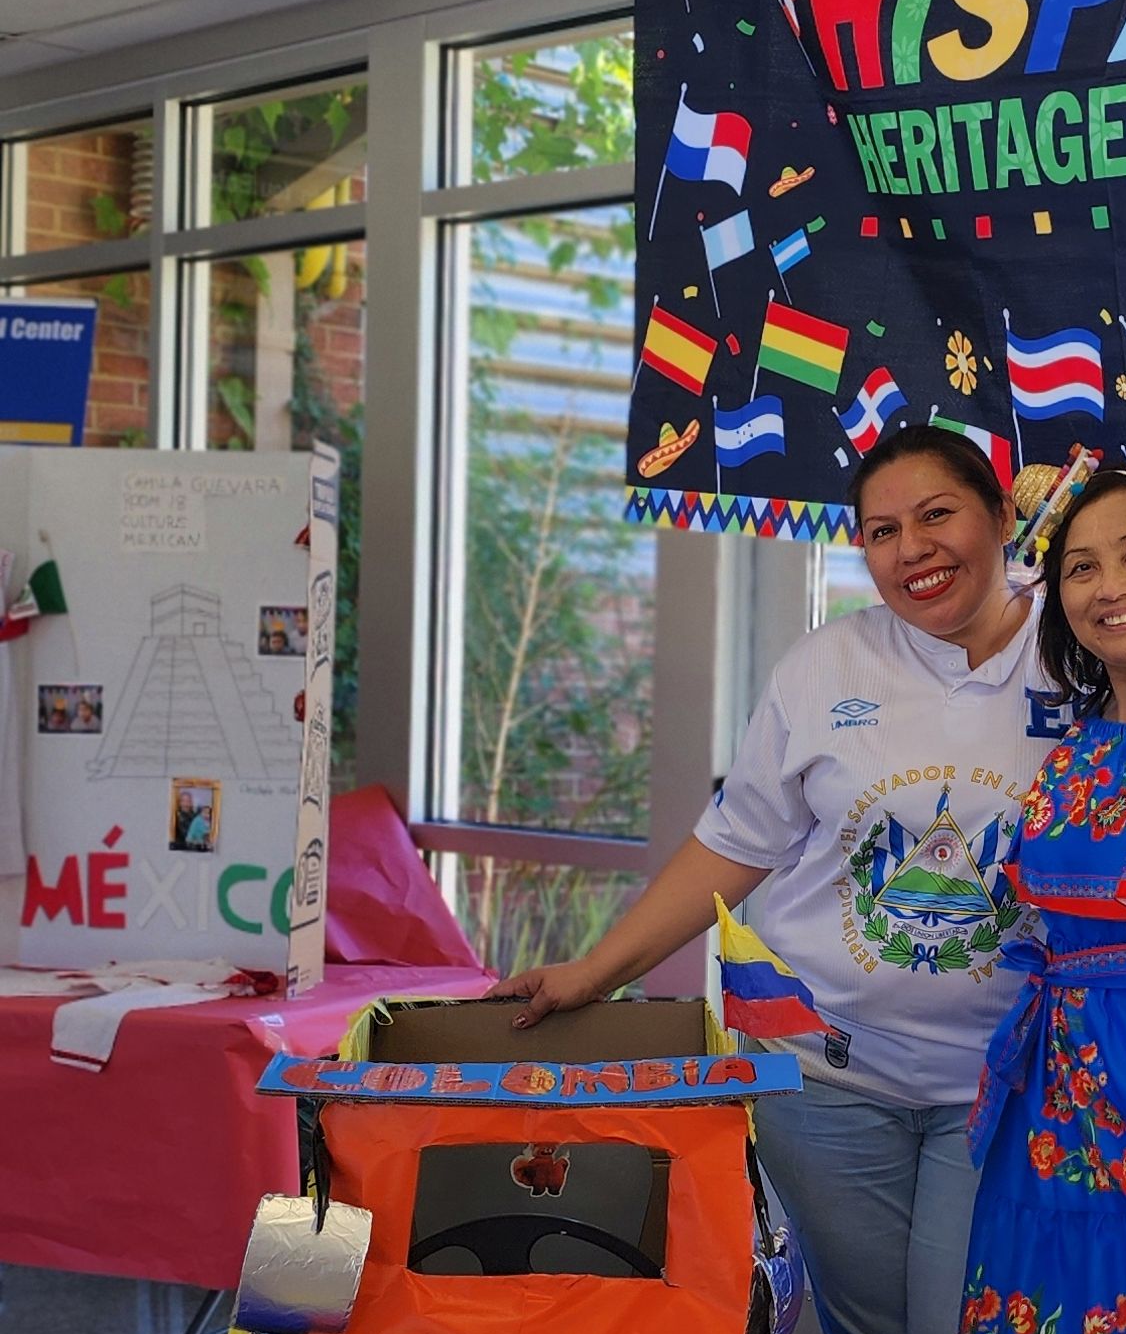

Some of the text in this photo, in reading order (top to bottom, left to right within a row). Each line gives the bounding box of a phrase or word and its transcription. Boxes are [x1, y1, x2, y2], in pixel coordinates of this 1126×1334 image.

[10, 317, 84, 341] Center
[123, 532, 201, 548] MEXICAN
[848, 765, 956, 824] SALVADOR
[971, 768, 1003, 790] EN
